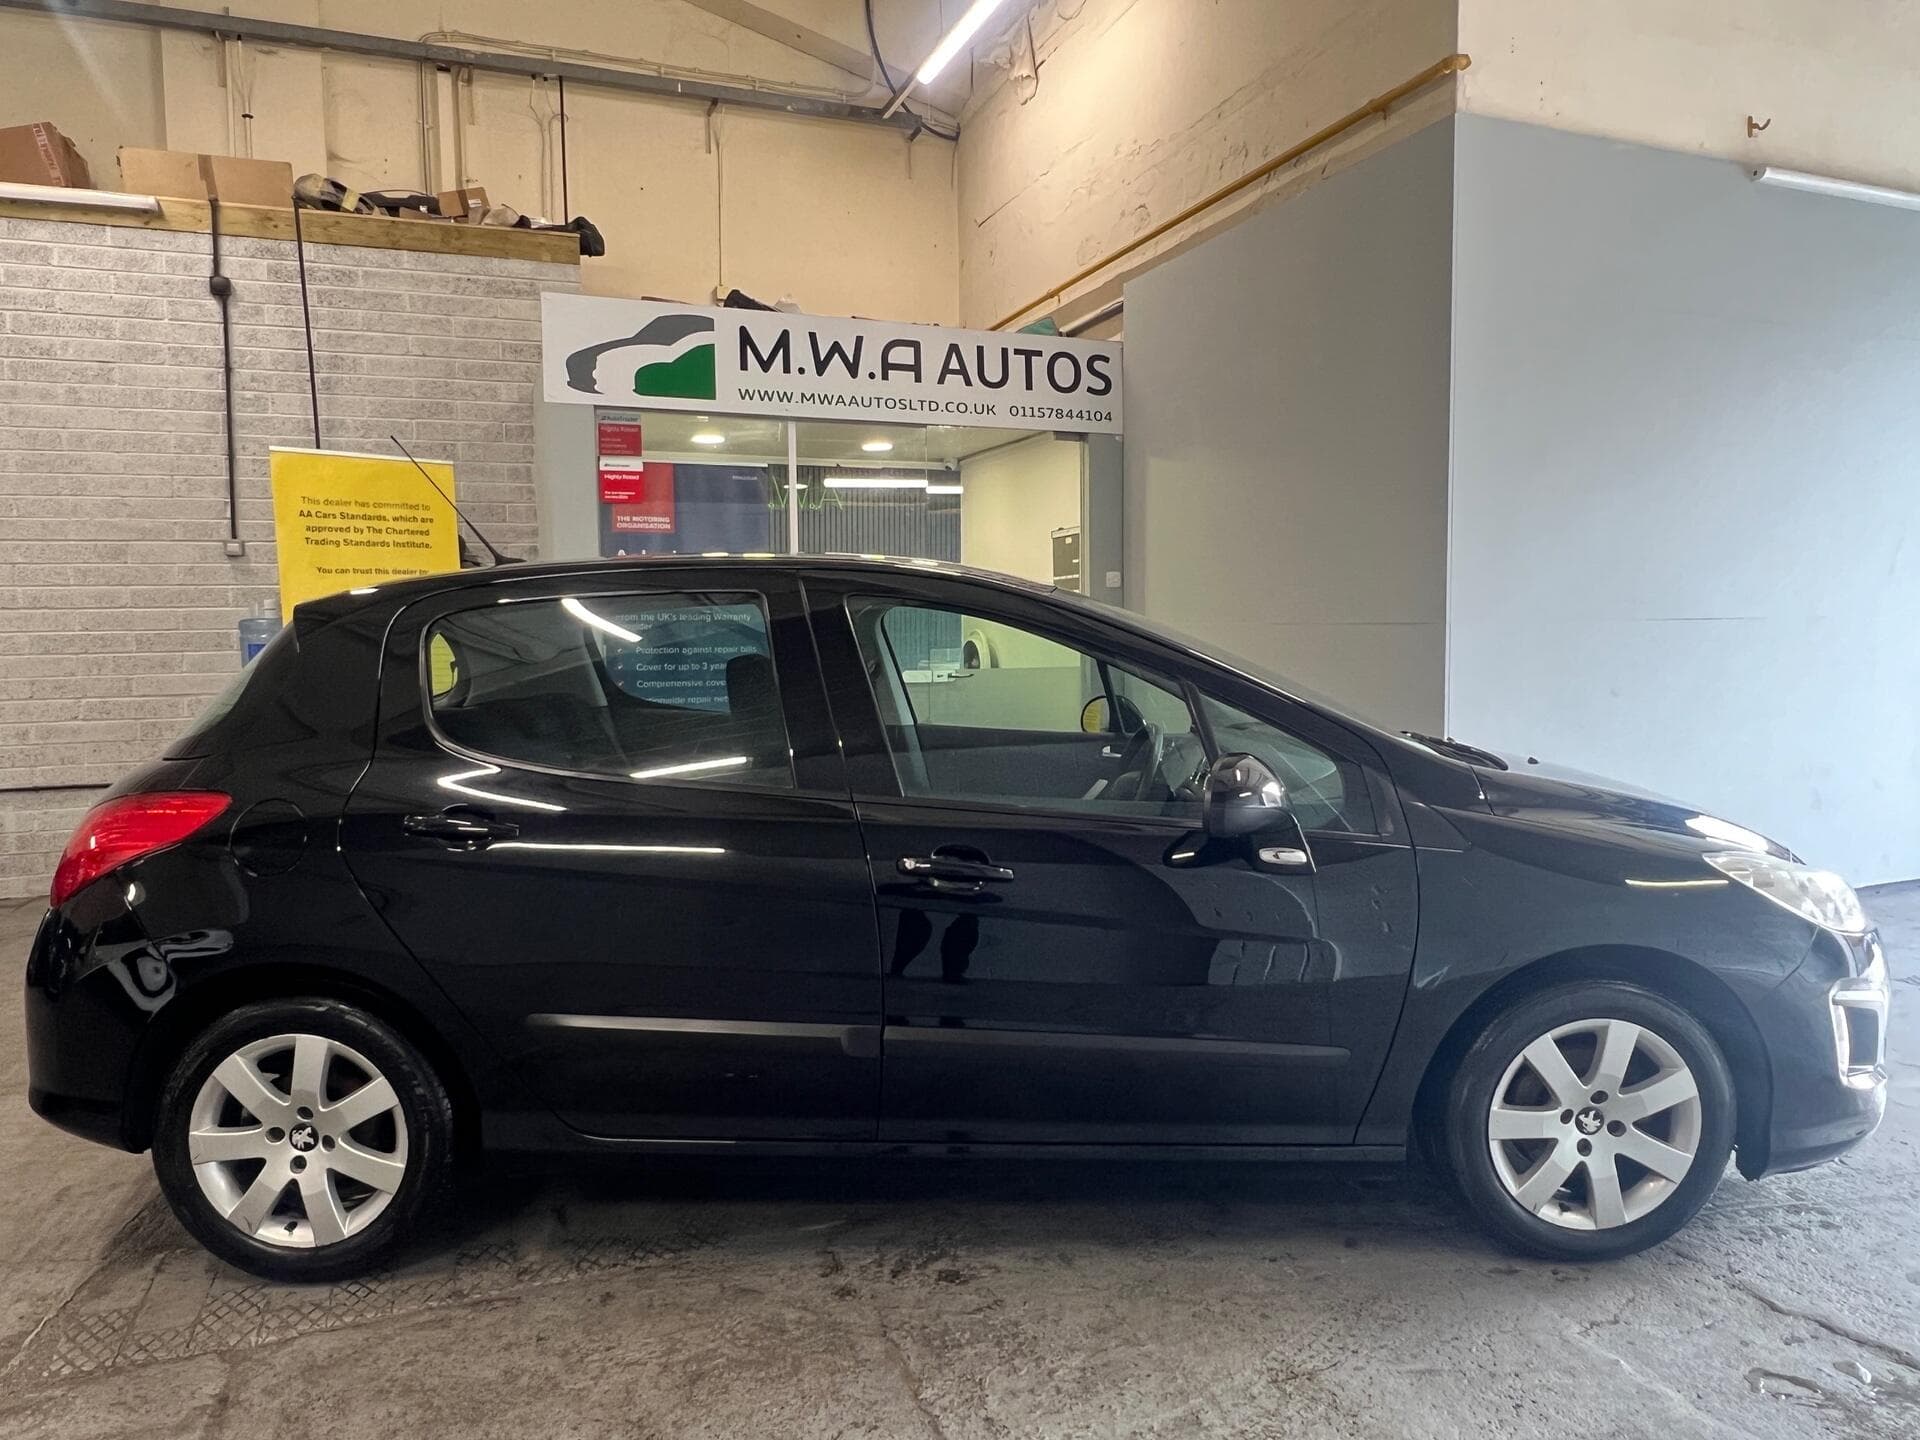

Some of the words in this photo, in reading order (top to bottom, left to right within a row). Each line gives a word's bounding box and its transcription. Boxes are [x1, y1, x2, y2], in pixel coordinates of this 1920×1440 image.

[739, 325, 922, 383] M.W.A
[937, 343, 1112, 396] AUTOS
[738, 388, 996, 416] WWW.MWAAUTOSLTD.CO.UK
[1009, 405, 1112, 421] 01157844104
[301, 496, 320, 505] This
[323, 498, 351, 506] dealer
[354, 499, 370, 508] has
[373, 501, 419, 511] committed
[421, 503, 431, 511] to
[299, 509, 313, 518] AA
[315, 510, 337, 519] Cars
[392, 514, 418, 523] which
[305, 525, 351, 534] approved
[353, 525, 364, 535] by
[366, 526, 383, 534] The
[385, 527, 430, 536] Chartered
[304, 537, 340, 548] Trading
[343, 538, 391, 548] Standards
[316, 566, 333, 574] You
[352, 567, 373, 575] trust
[374, 567, 389, 575] this
[713, 612, 751, 622] Warranty
[635, 646, 680, 655] Protection
[682, 646, 712, 655] against
[714, 646, 738, 655] repair
[636, 663, 661, 671] Cover
[664, 663, 676, 671] for
[678, 664, 690, 672] up
[691, 663, 700, 671] to
[702, 662, 708, 670] 3
[636, 680, 703, 688] Comprehensive
[687, 696, 713, 704] repair
